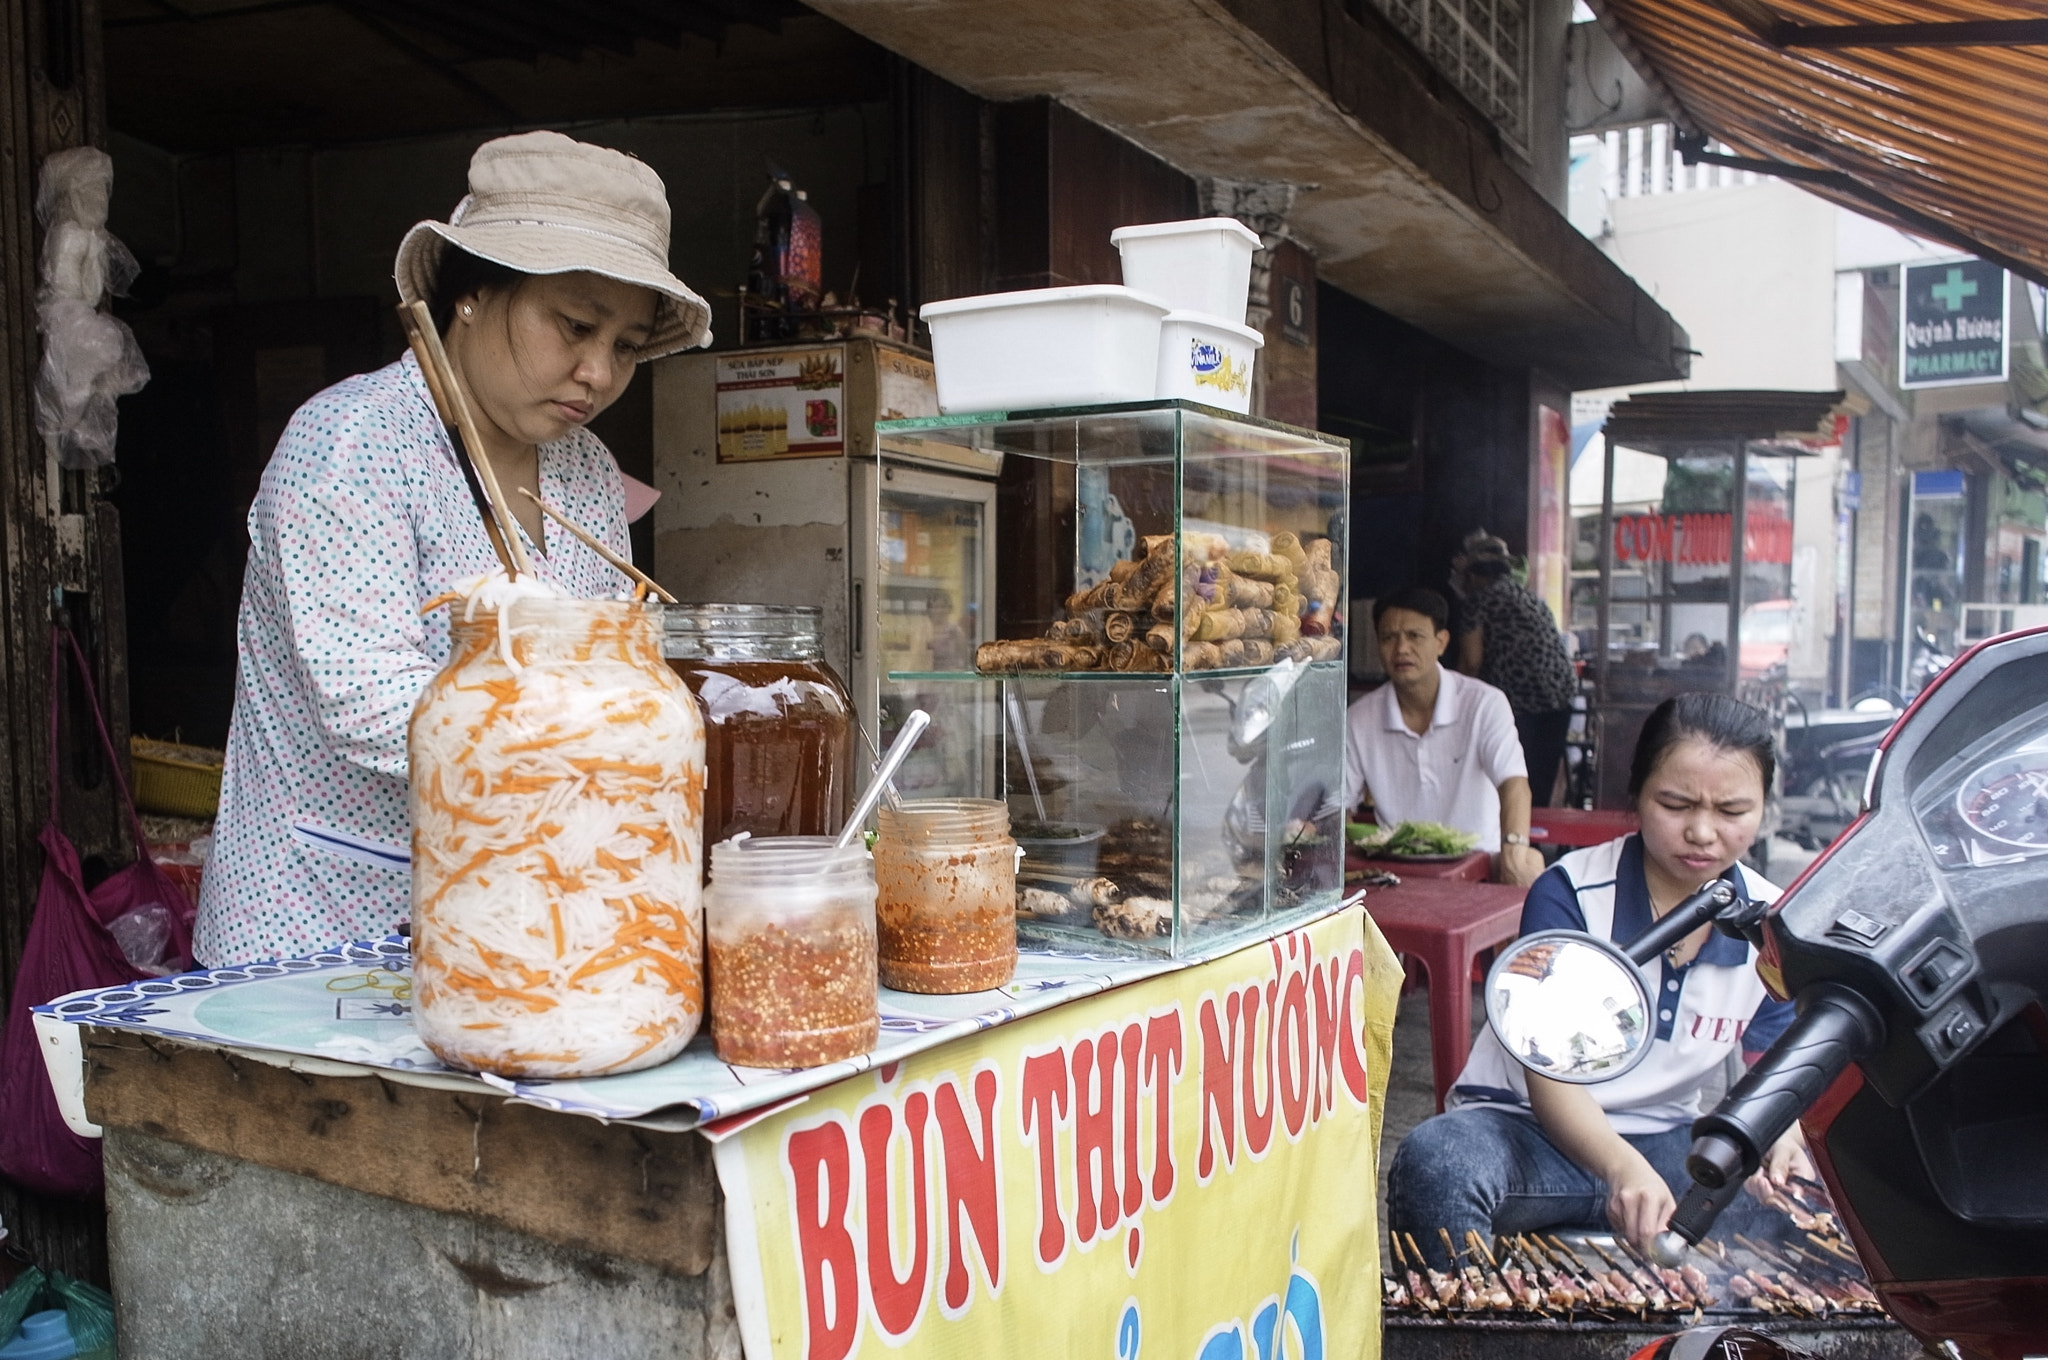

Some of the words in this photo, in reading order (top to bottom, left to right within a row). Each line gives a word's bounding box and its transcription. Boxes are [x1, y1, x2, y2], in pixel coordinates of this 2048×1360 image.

[1289, 285, 1303, 327] 6
[1906, 349, 1999, 377] PHARMACY
[1022, 1008, 1182, 1269] THỊT
